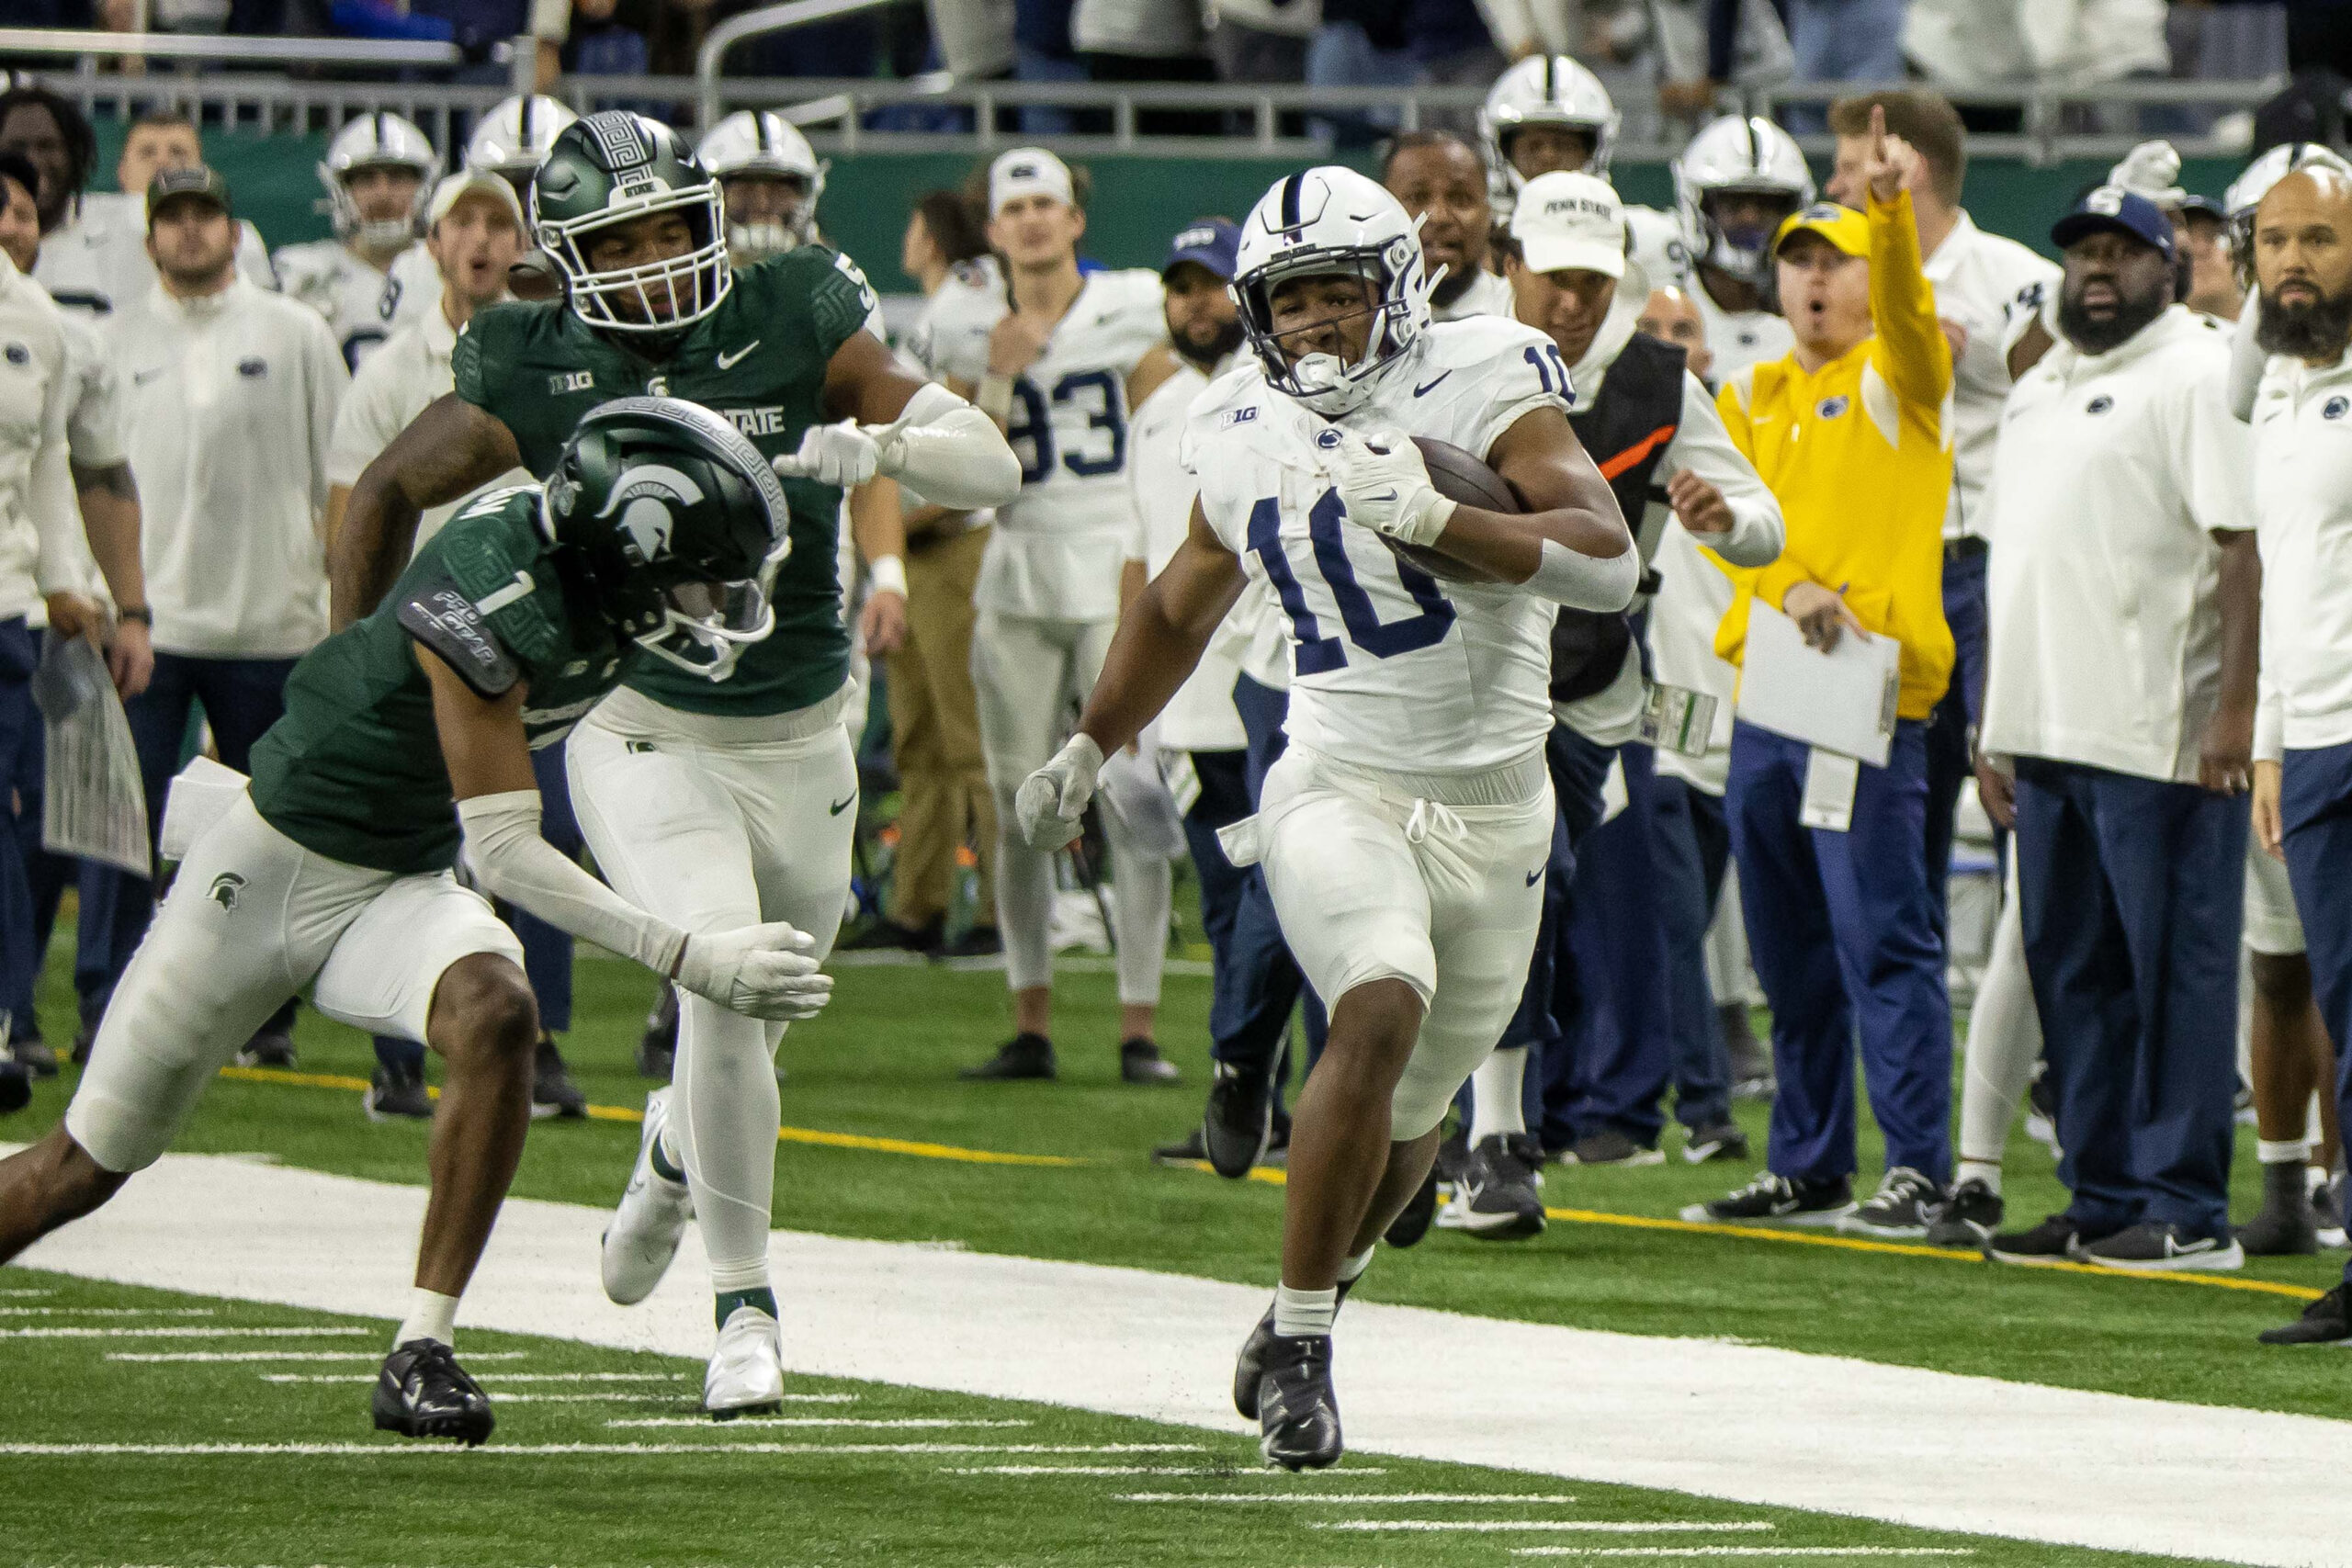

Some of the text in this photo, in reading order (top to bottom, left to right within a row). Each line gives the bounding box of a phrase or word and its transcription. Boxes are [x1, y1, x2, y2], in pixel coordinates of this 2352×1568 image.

[1544, 197, 1611, 221] PENN STATE
[720, 405, 786, 435] TATE
[1246, 486, 1457, 677] 10
